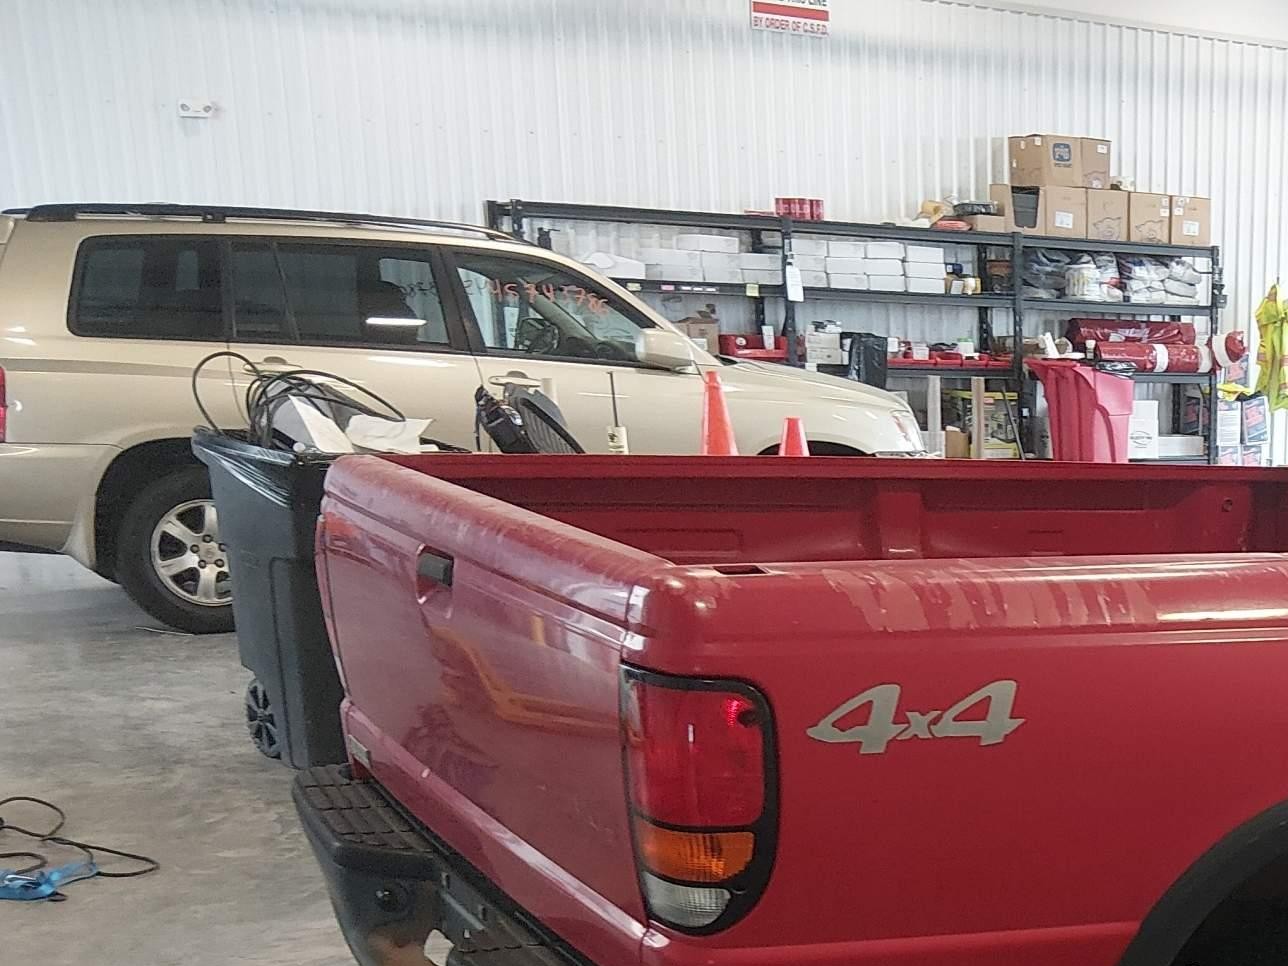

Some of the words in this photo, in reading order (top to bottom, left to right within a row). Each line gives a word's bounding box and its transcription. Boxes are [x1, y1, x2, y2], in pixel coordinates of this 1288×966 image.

[753, 15, 764, 27] BY
[765, 17, 790, 30] ORDER
[791, 20, 802, 32] OF
[806, 680, 1027, 755] 4x4
